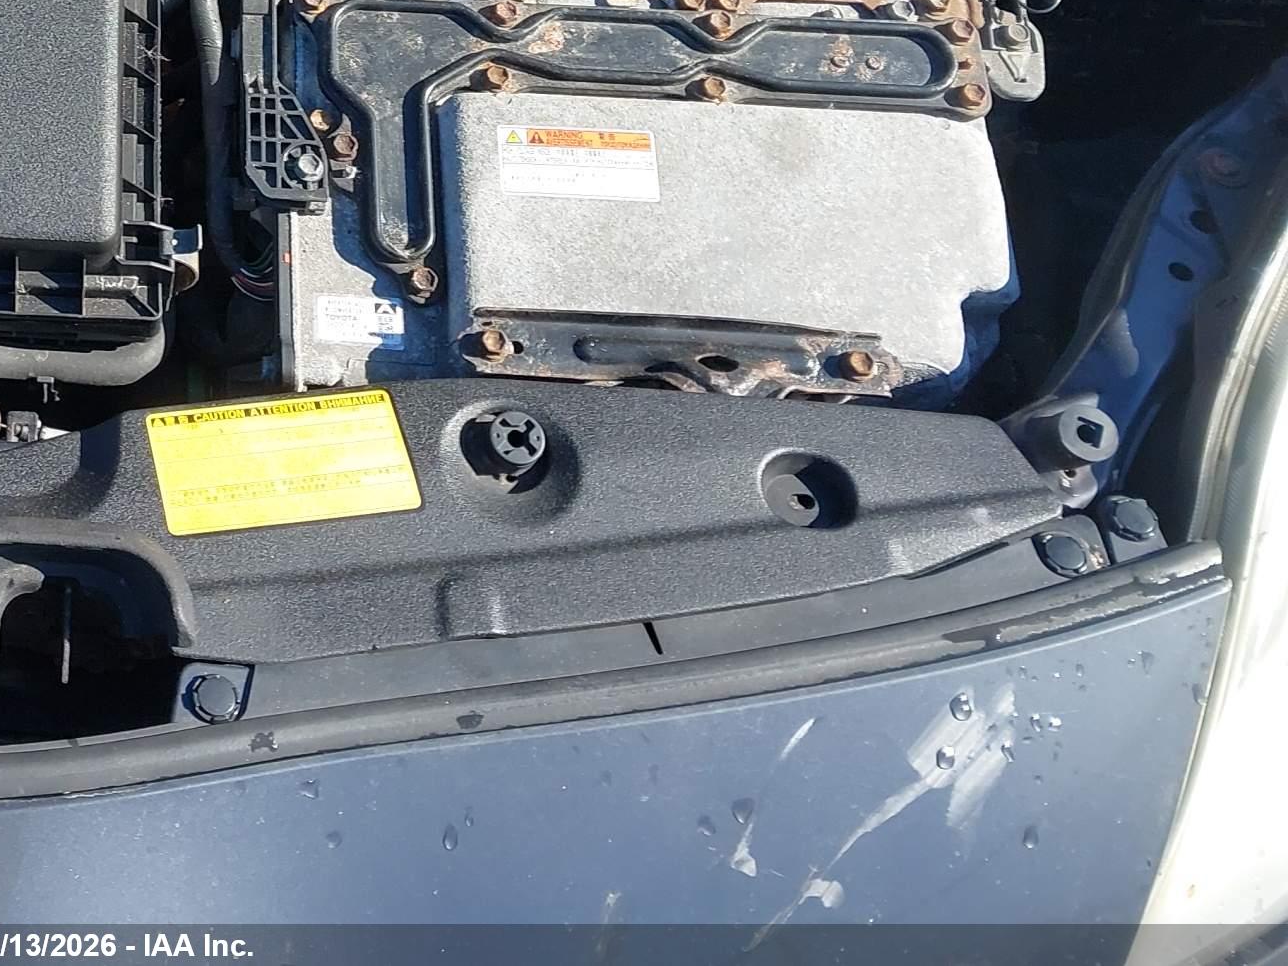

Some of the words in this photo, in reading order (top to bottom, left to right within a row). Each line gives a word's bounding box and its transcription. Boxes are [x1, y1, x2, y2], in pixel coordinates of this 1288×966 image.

[546, 131, 583, 140] WARNING
[325, 313, 360, 321] TOYOTA
[193, 409, 245, 424] CAUTION
[251, 401, 315, 417] ATTENTION
[321, 394, 385, 410] ВНИМАНИЕ
